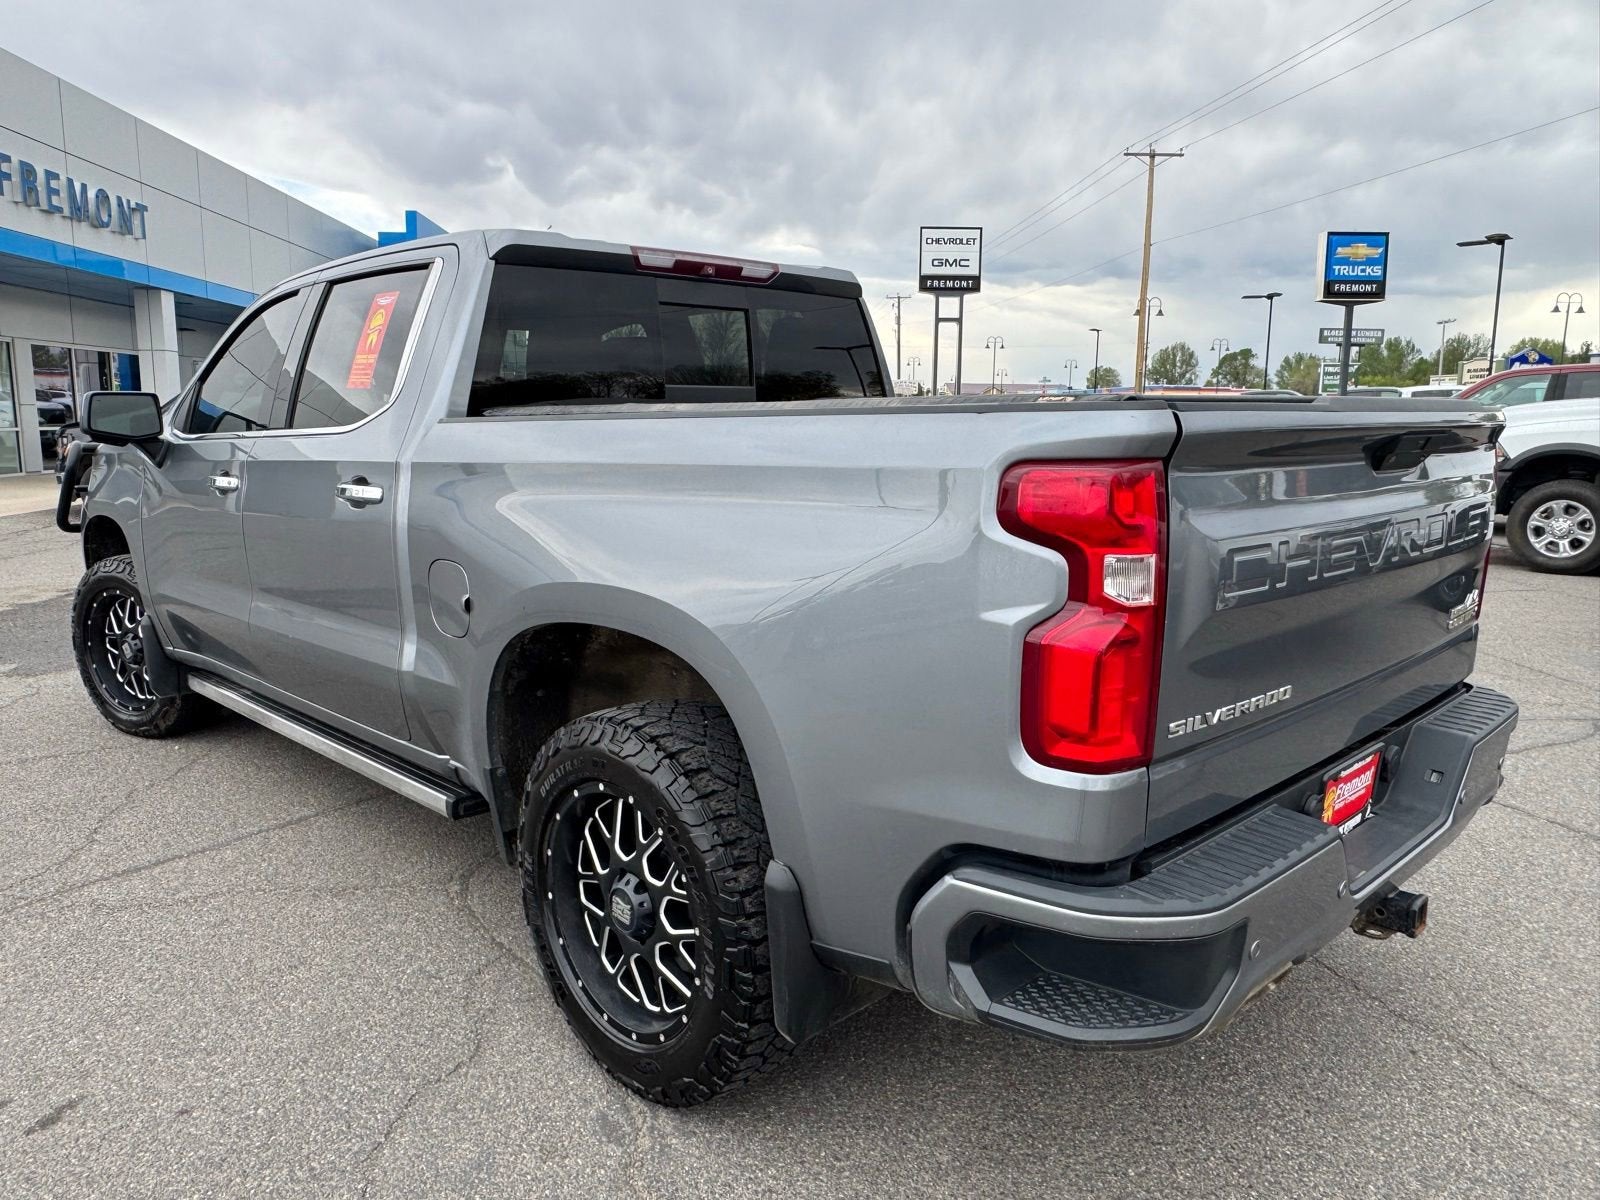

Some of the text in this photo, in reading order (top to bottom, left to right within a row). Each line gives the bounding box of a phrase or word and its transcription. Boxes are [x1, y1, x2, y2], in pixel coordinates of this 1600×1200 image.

[0, 152, 148, 240] FREMONT
[925, 237, 977, 245] CHEVROLET
[931, 258, 970, 267] GMC
[1333, 265, 1382, 276] TRUCKS
[927, 280, 973, 288] FREMONT
[1334, 283, 1377, 292] FREMONT
[1167, 685, 1292, 739] SILVERADO
[1334, 766, 1376, 801] Fremont
